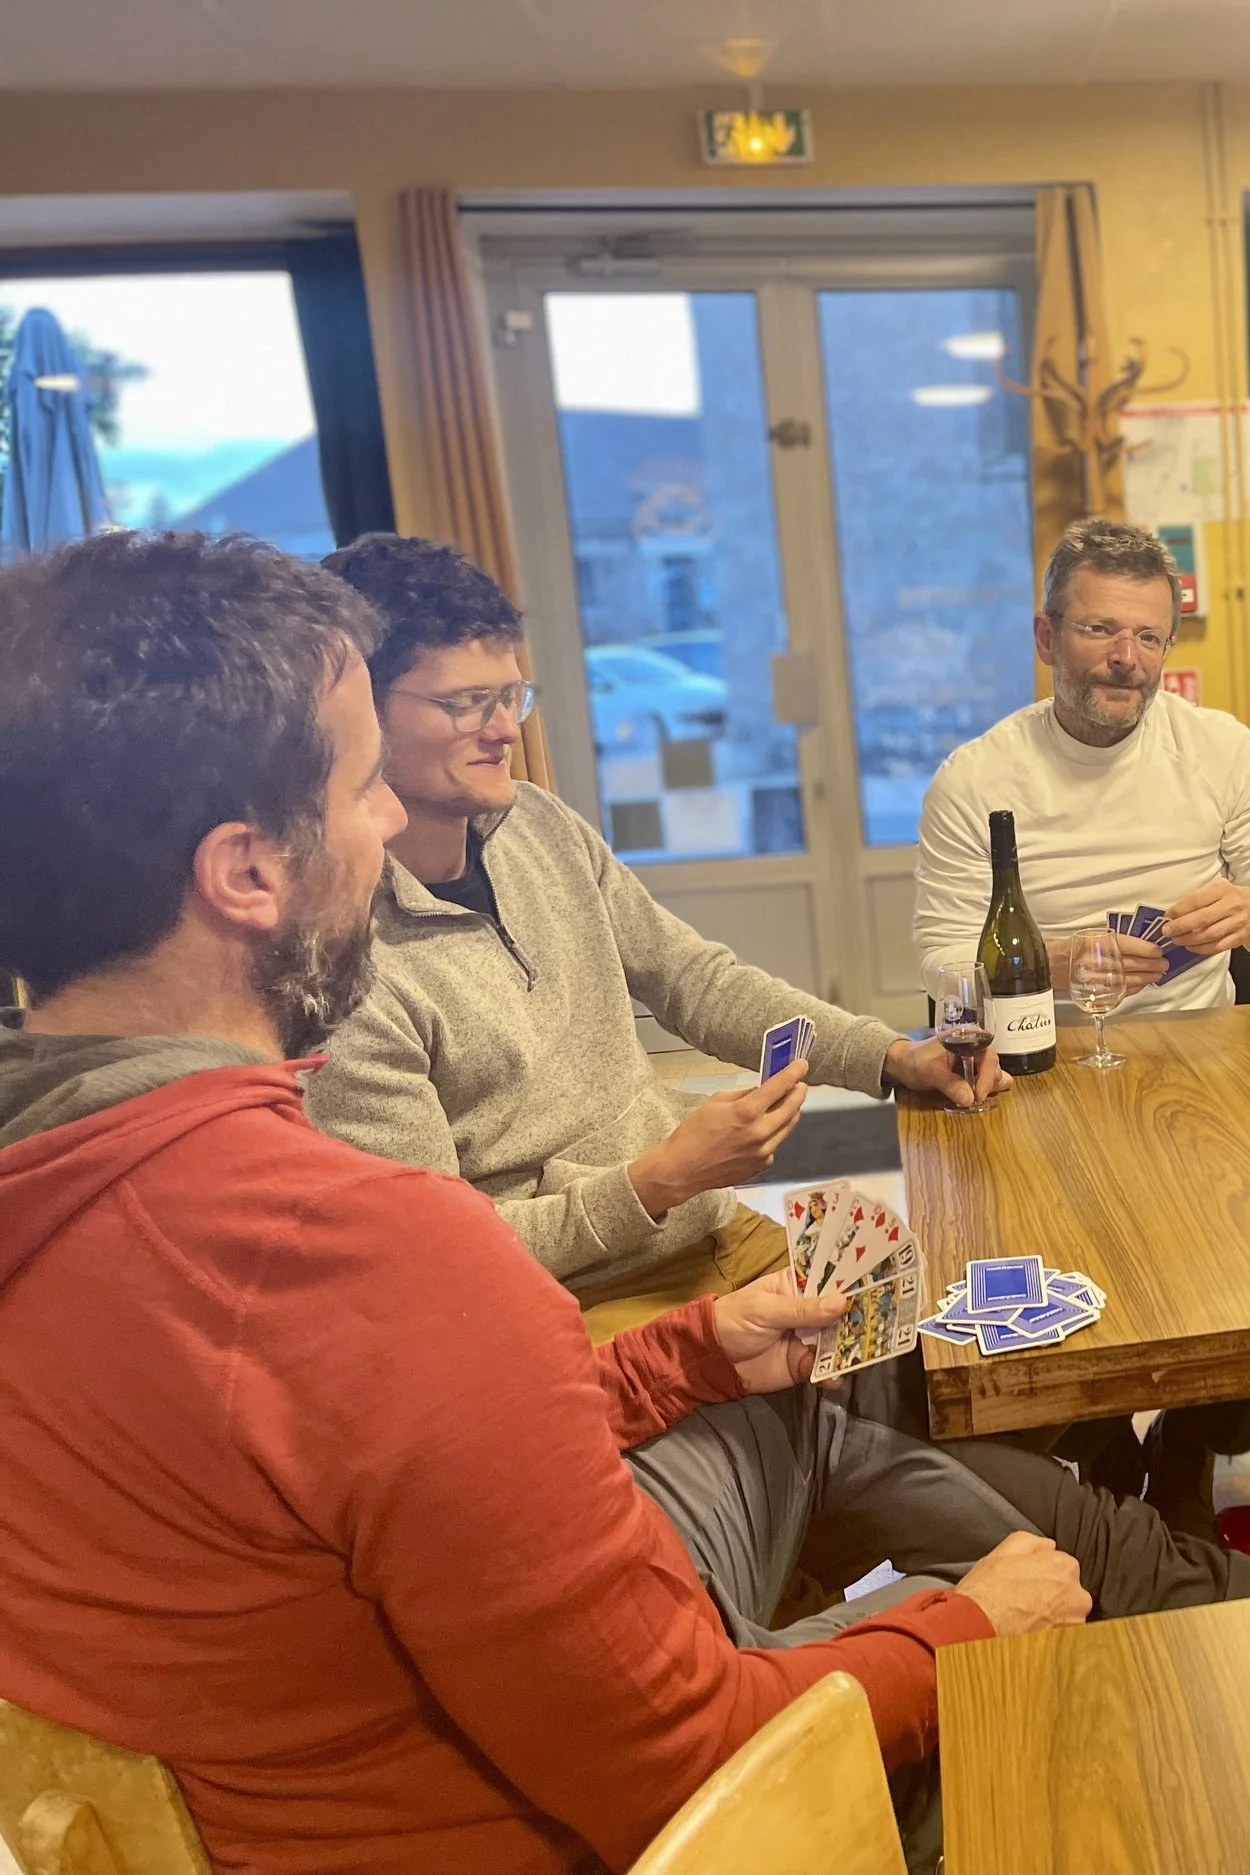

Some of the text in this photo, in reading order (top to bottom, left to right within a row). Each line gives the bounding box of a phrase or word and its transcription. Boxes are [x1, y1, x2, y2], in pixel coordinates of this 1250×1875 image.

[834, 1192, 840, 1205] 3
[898, 1243, 914, 1266] 19
[902, 1275, 915, 1296] 21
[897, 1326, 912, 1347] 21
[818, 1355, 833, 1374] 21
